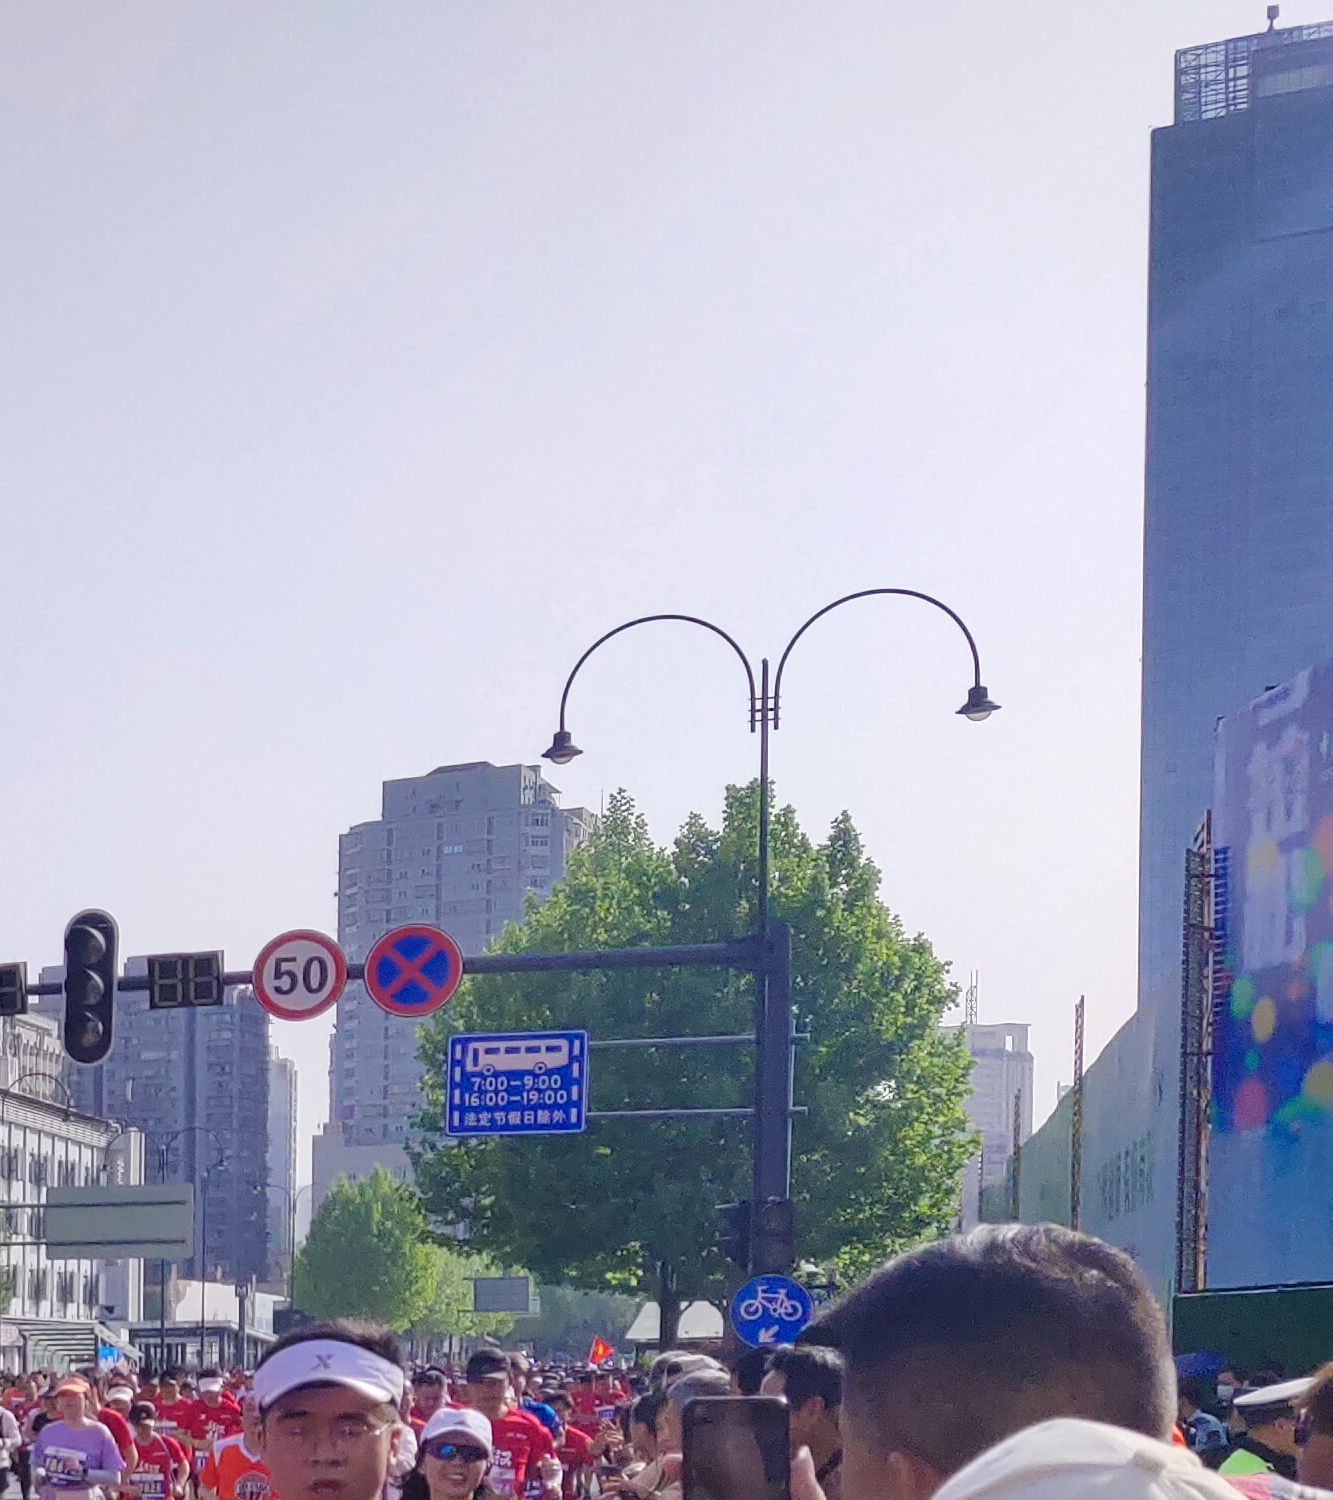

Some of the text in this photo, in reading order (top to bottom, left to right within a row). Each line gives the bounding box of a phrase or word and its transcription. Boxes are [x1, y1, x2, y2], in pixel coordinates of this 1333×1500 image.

[274, 956, 328, 995] 50
[463, 1109, 567, 1127] 法定节假日除外
